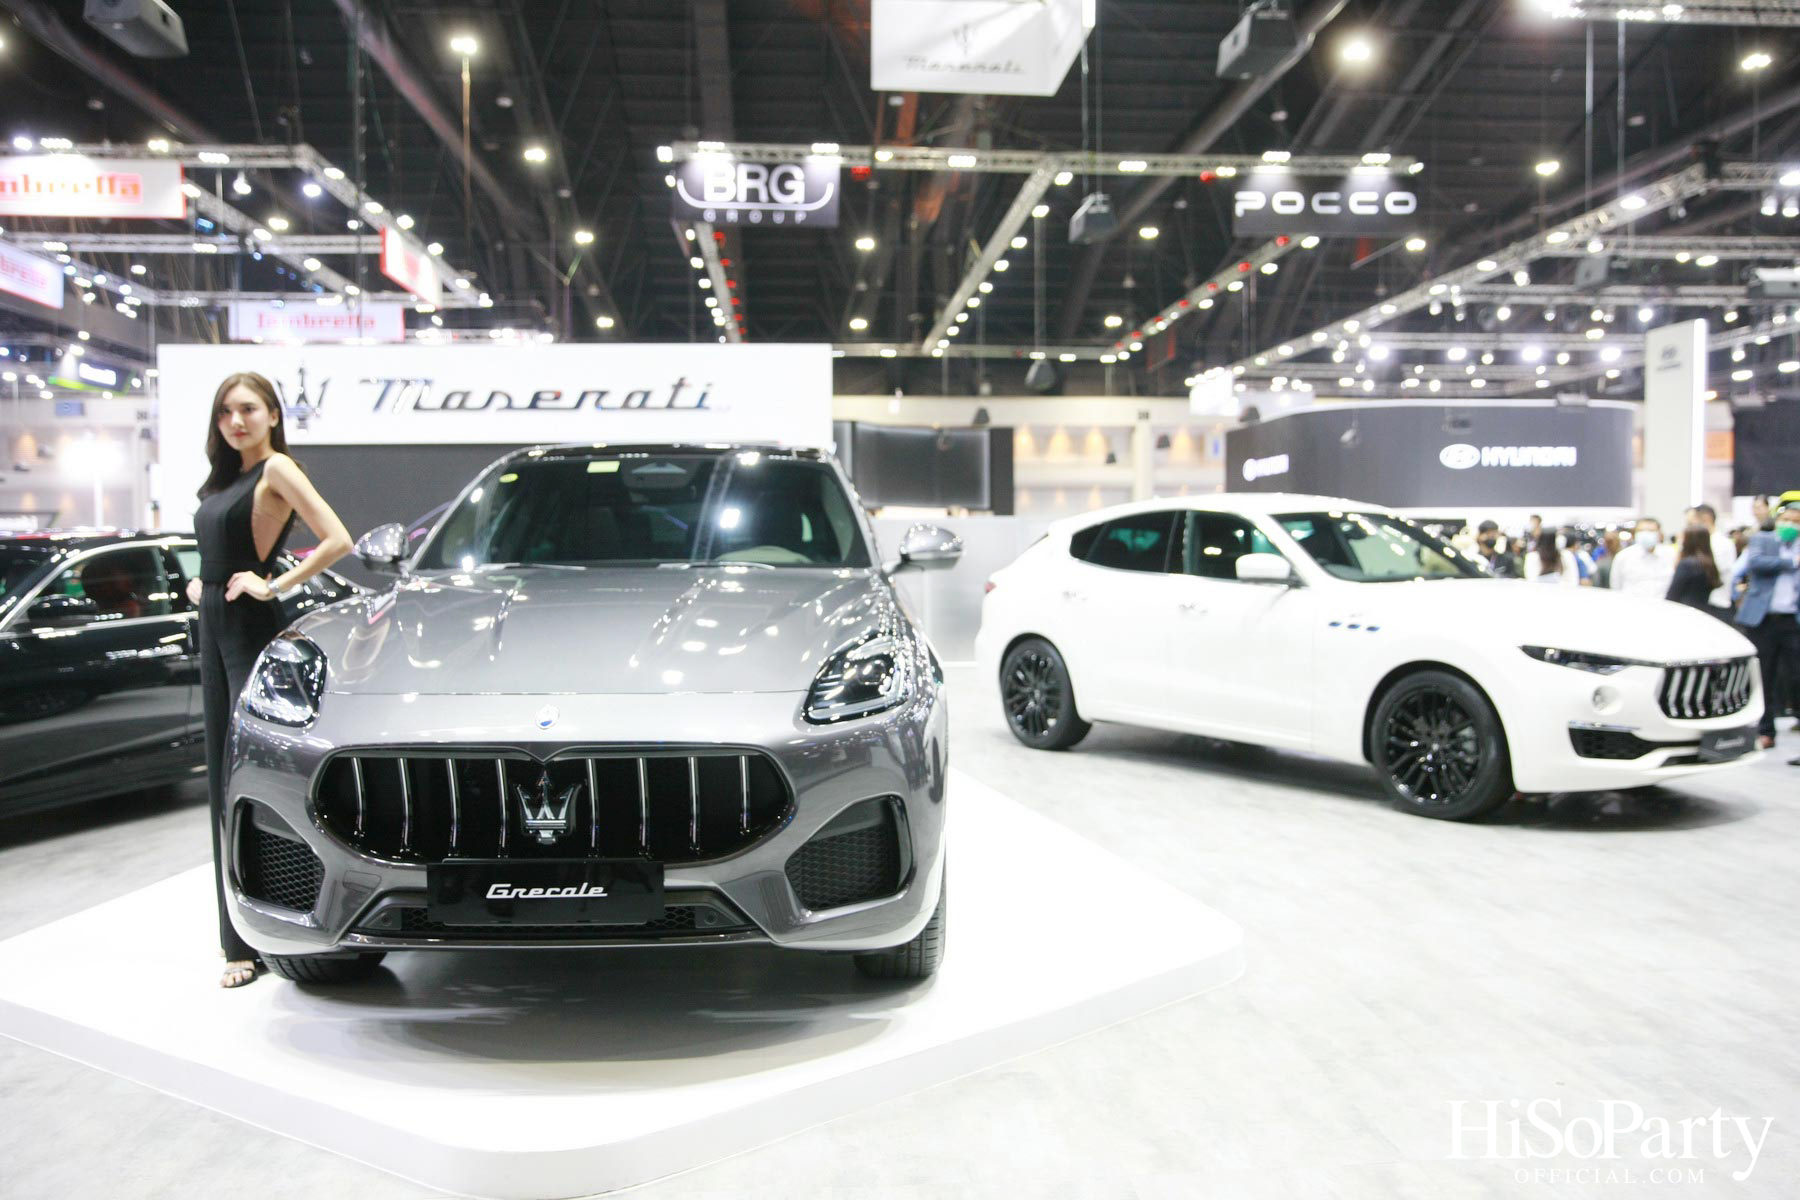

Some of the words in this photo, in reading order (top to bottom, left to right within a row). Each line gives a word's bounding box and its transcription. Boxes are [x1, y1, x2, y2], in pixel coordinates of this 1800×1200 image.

[703, 162, 805, 204] BRG
[1234, 191, 1417, 217] POCCO
[703, 208, 807, 225] GROUP
[358, 376, 713, 413] Maserati
[1481, 446, 1577, 467] HYUNDAI
[486, 882, 608, 899] Grecale
